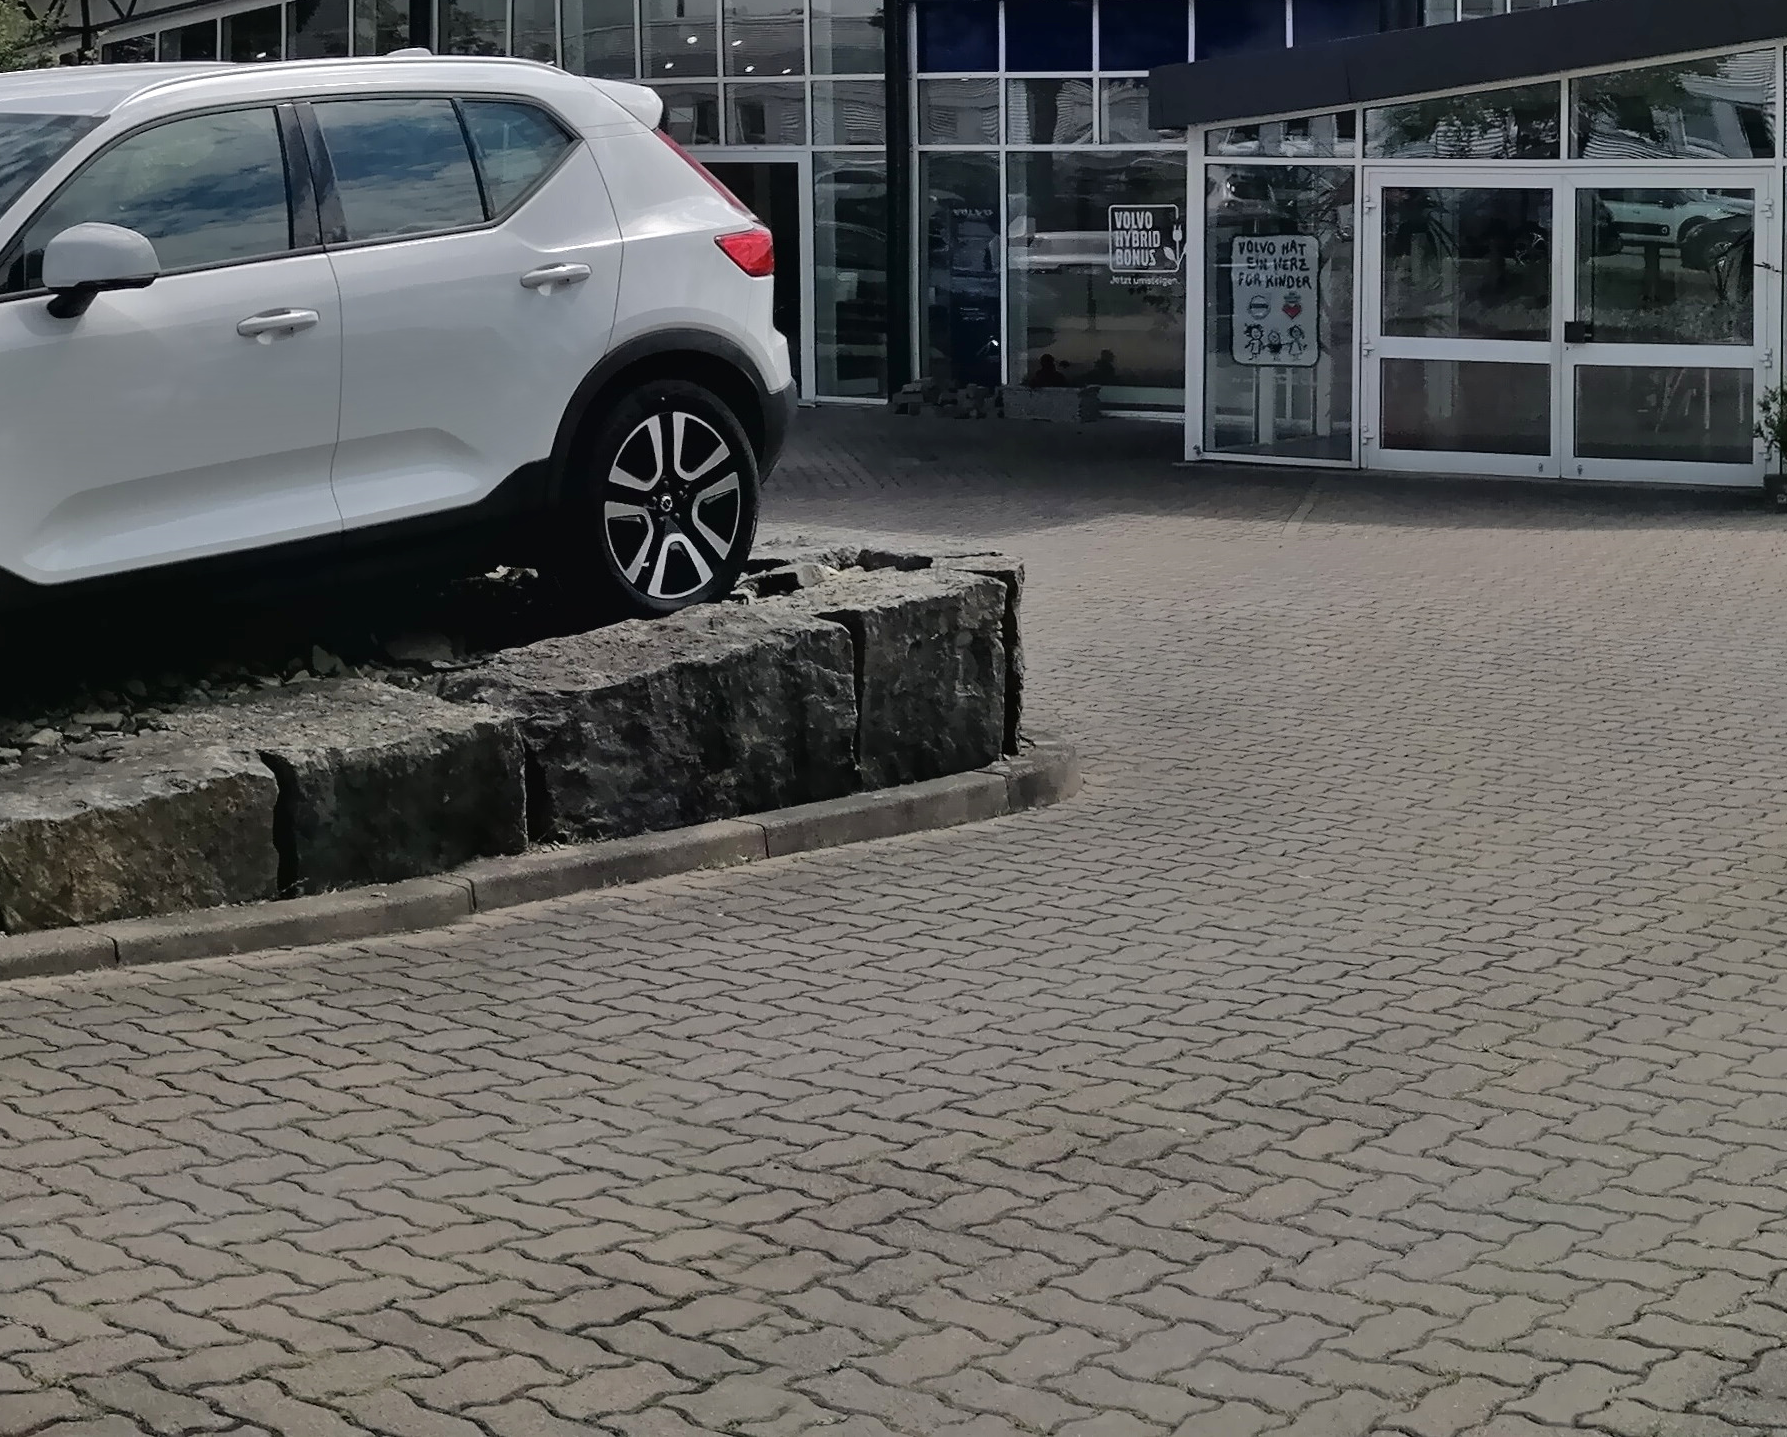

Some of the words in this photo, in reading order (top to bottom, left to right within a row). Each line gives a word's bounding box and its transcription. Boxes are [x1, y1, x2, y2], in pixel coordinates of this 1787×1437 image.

[1114, 211, 1153, 230] VOLVO
[1114, 230, 1161, 248] HYBRID
[1238, 240, 1276, 255] VOLVO
[1282, 239, 1307, 256] HAT
[1115, 248, 1157, 266] BONUS
[1274, 257, 1310, 272] HERZ
